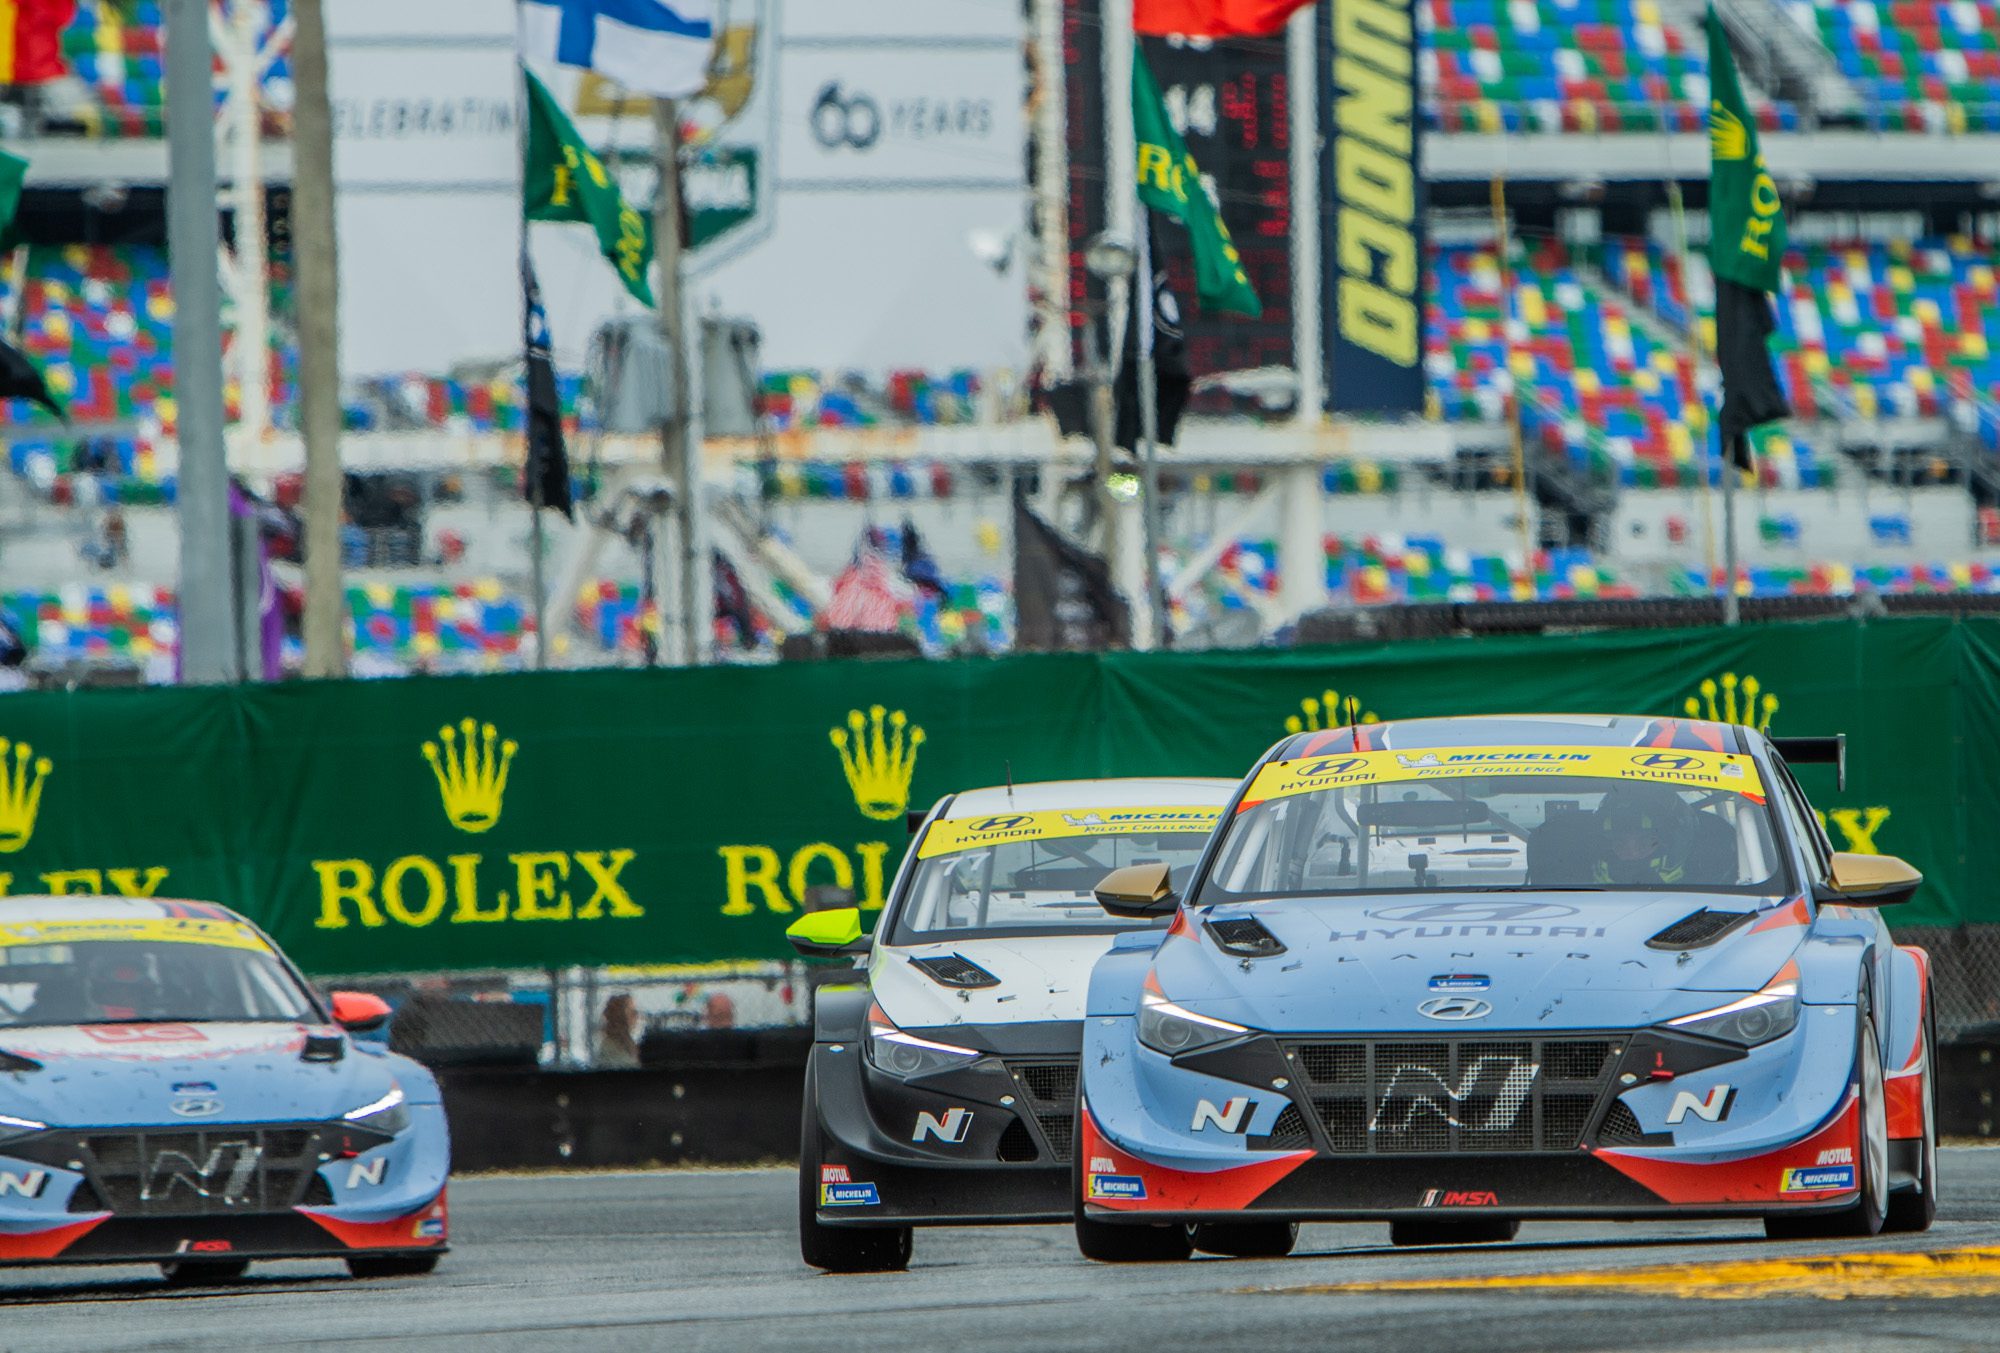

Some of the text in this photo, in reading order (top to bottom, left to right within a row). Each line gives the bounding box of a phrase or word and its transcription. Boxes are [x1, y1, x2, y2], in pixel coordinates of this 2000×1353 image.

[811, 80, 992, 151] 60 YEARS
[1333, 0, 1418, 367] UNOCO
[1448, 753, 1592, 762] MICHELIN
[1417, 766, 1565, 776] PILOT CHALLENGE
[1621, 769, 1719, 783] HYUNDAI
[1280, 772, 1377, 791] HYUNDAI
[956, 829, 1042, 843] HYUNDAI
[940, 852, 991, 876] 77
[312, 849, 645, 928] ROLEX
[1329, 925, 1605, 942] HYUNDAI
[1817, 1147, 1853, 1165] MOTUL
[822, 1168, 849, 1182] MOTUL
[1804, 1172, 1849, 1184] MICHELIN
[835, 1190, 872, 1199] MICHELIN
[1103, 1182, 1139, 1192] MICHELIN
[1442, 1190, 1499, 1206] IMSA
